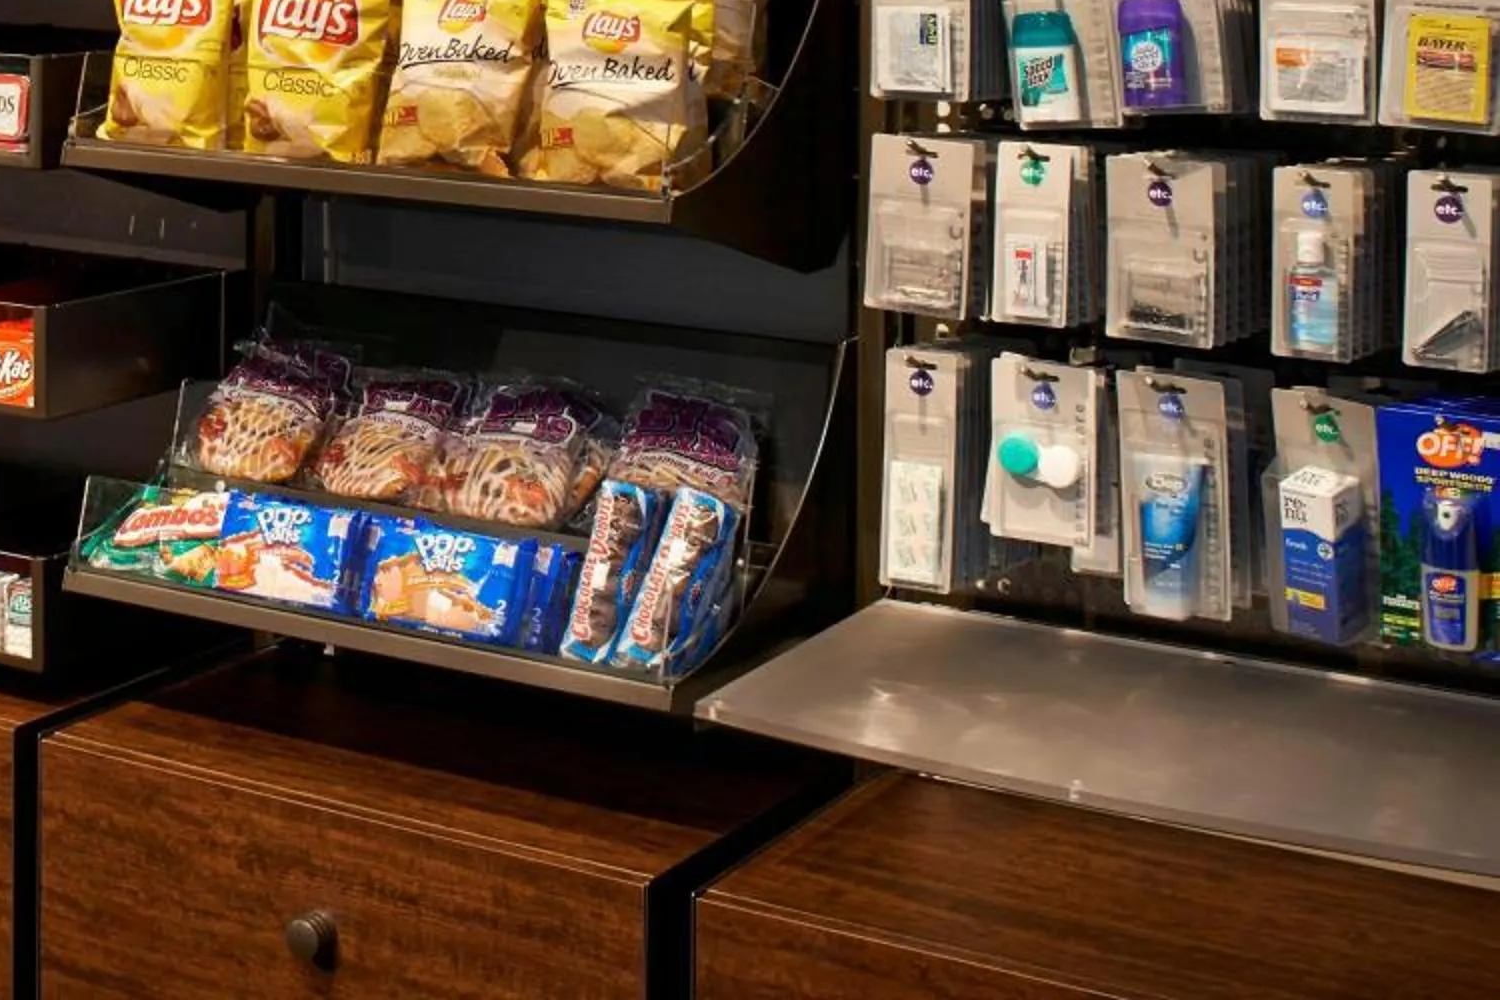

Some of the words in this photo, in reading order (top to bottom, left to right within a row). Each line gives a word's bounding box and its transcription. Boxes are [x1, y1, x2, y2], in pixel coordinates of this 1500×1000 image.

[585, 10, 640, 38] Lay's
[445, 35, 513, 63] Baked
[123, 56, 190, 84] Classic
[602, 55, 676, 82] Baked
[263, 71, 335, 99] Classic
[629, 560, 668, 643] CHOCOLAT
